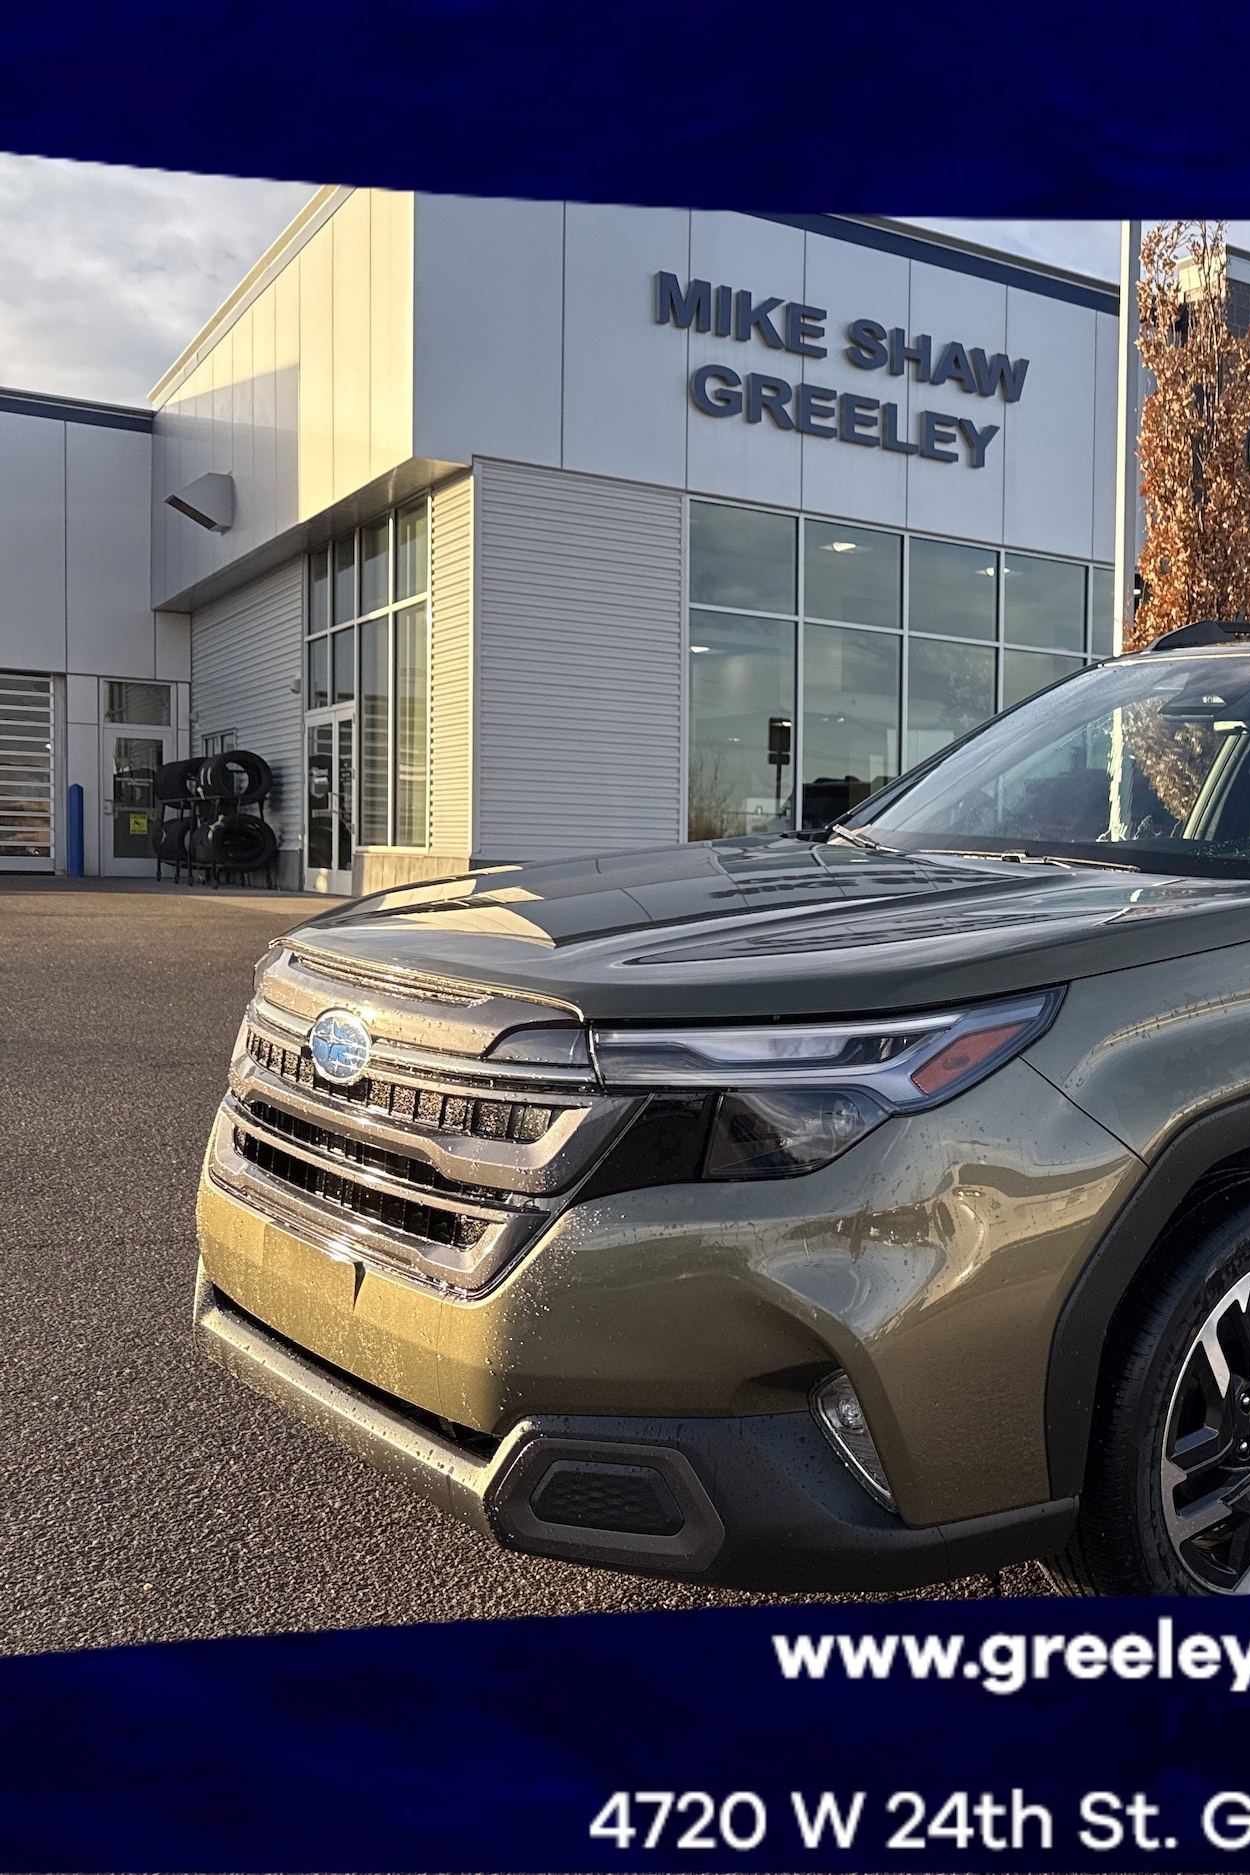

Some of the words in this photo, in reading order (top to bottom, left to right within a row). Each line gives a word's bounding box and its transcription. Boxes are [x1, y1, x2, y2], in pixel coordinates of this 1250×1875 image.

[655, 271, 827, 358] MIKE
[846, 319, 1030, 402] SHAW
[691, 364, 1000, 468] GREELEY
